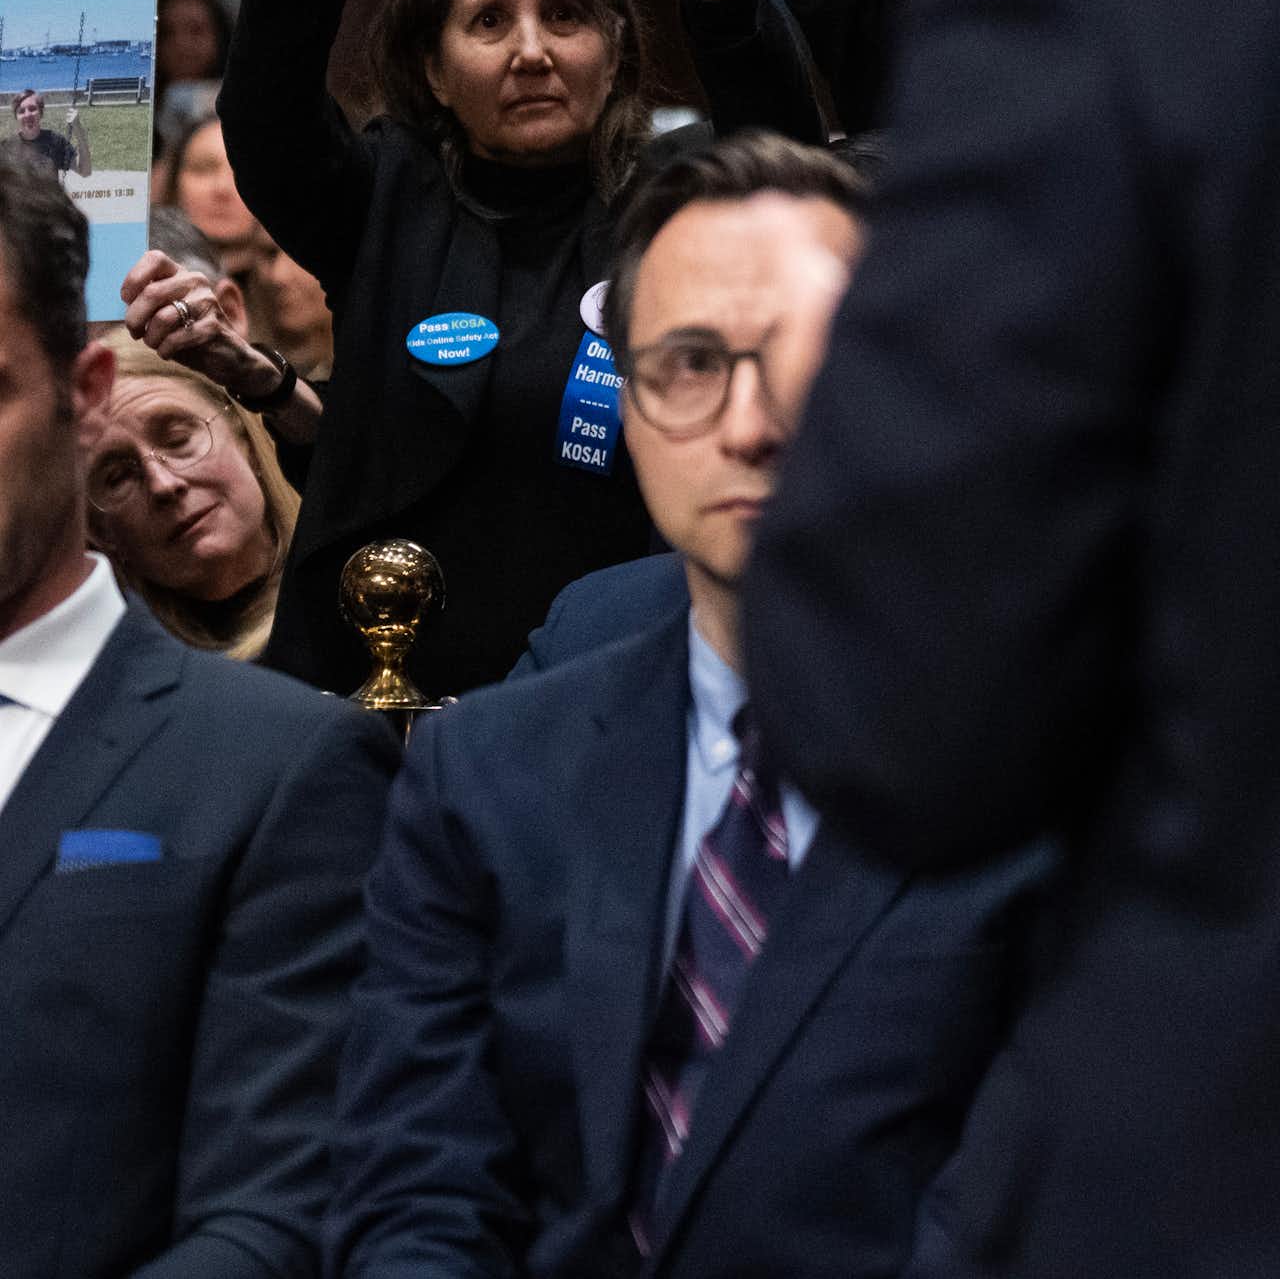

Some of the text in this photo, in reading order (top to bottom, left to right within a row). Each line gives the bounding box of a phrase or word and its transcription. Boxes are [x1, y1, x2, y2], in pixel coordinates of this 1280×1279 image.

[419, 318, 487, 334] Pass KOSA
[427, 335, 455, 346] Online
[455, 333, 482, 343] Safety
[438, 346, 471, 360] Now!
[571, 416, 607, 441] Pass
[561, 440, 608, 467] KOSA!
